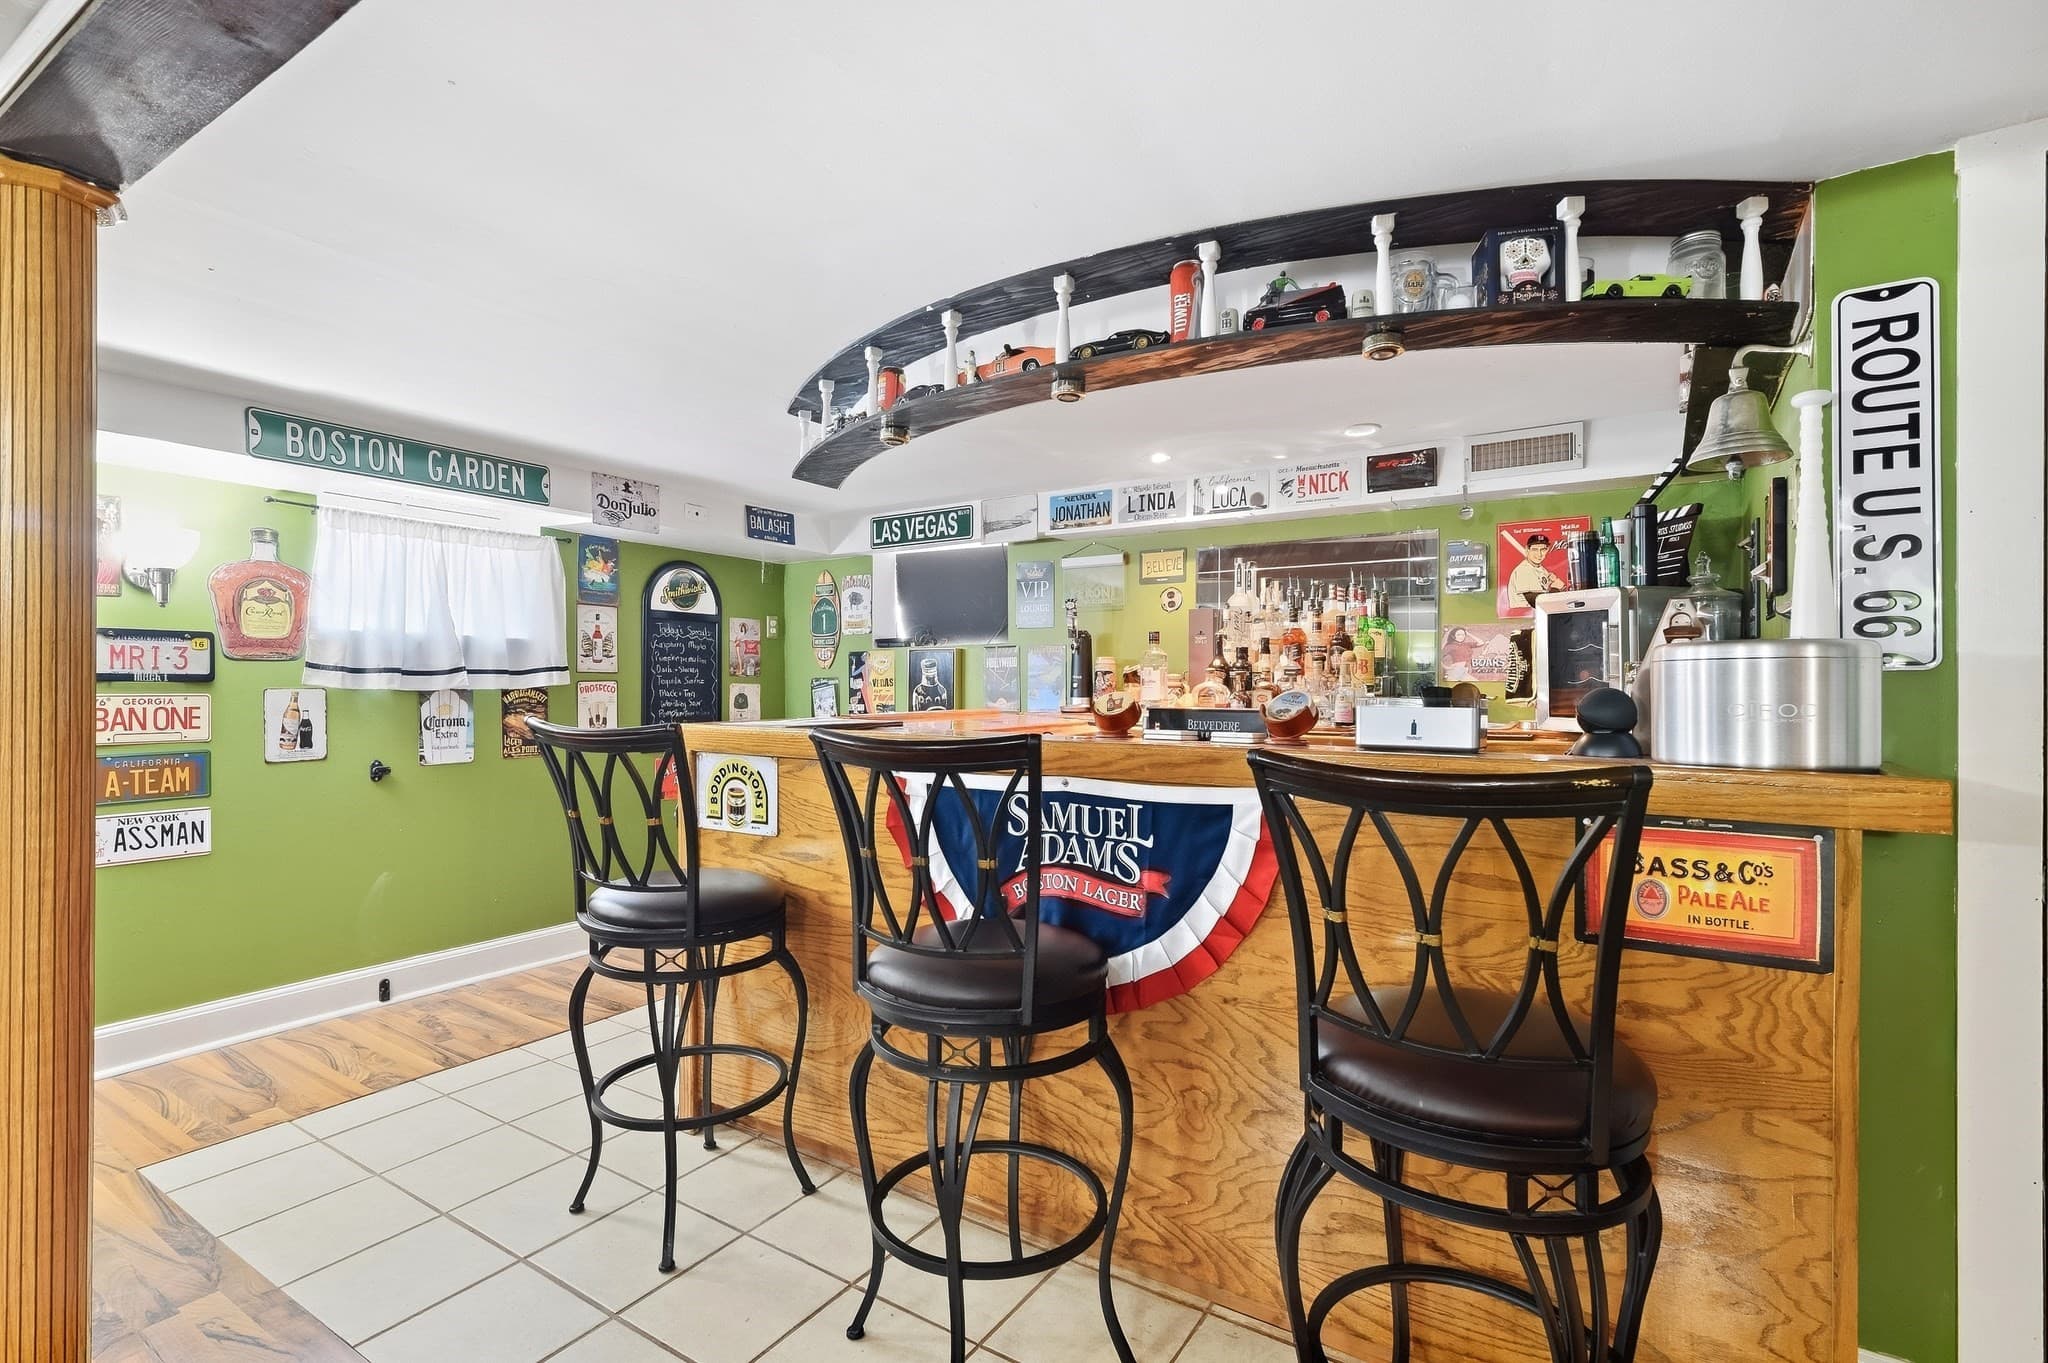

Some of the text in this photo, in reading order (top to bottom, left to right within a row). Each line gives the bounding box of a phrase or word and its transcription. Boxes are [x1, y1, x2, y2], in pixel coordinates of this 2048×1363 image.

[1174, 294, 1189, 336] TOWER
[284, 421, 526, 497] BOSTON GARDEN
[1296, 462, 1340, 472] Massachusetts
[1309, 470, 1349, 495] NICK
[1851, 312, 1922, 639] ROUTE U.S. 66
[596, 493, 657, 520] Don Julio
[1064, 493, 1097, 502] NEVADA
[1128, 490, 1176, 514] LINDA
[1212, 486, 1248, 510] LUCA
[1052, 500, 1111, 523] JONATHAN
[750, 514, 790, 536] BALASHI
[872, 517, 901, 544] LAS
[904, 511, 959, 540] VEGAS
[1146, 556, 1183, 576] BELIEVE
[1450, 554, 1482, 562] DAYTONA
[1020, 580, 1049, 600] VIP
[580, 684, 616, 694] PROSECCO
[122, 698, 174, 706] GEORGIA
[96, 706, 201, 732] BAN ONE
[422, 716, 466, 732] Corona
[1187, 718, 1241, 732] BELVEDERE
[435, 728, 459, 739] Extra
[114, 758, 181, 769] CALIFORNIA
[105, 766, 190, 798] A-TEAM
[710, 762, 764, 809] BODDINGTONS
[117, 813, 180, 826] NEW YORK
[114, 820, 205, 853] ASSMAN
[1012, 873, 1142, 911] BTON LAGER
[1678, 884, 1729, 910] PALE
[1730, 890, 1770, 913] ALE
[1688, 914, 1700, 924] IN
